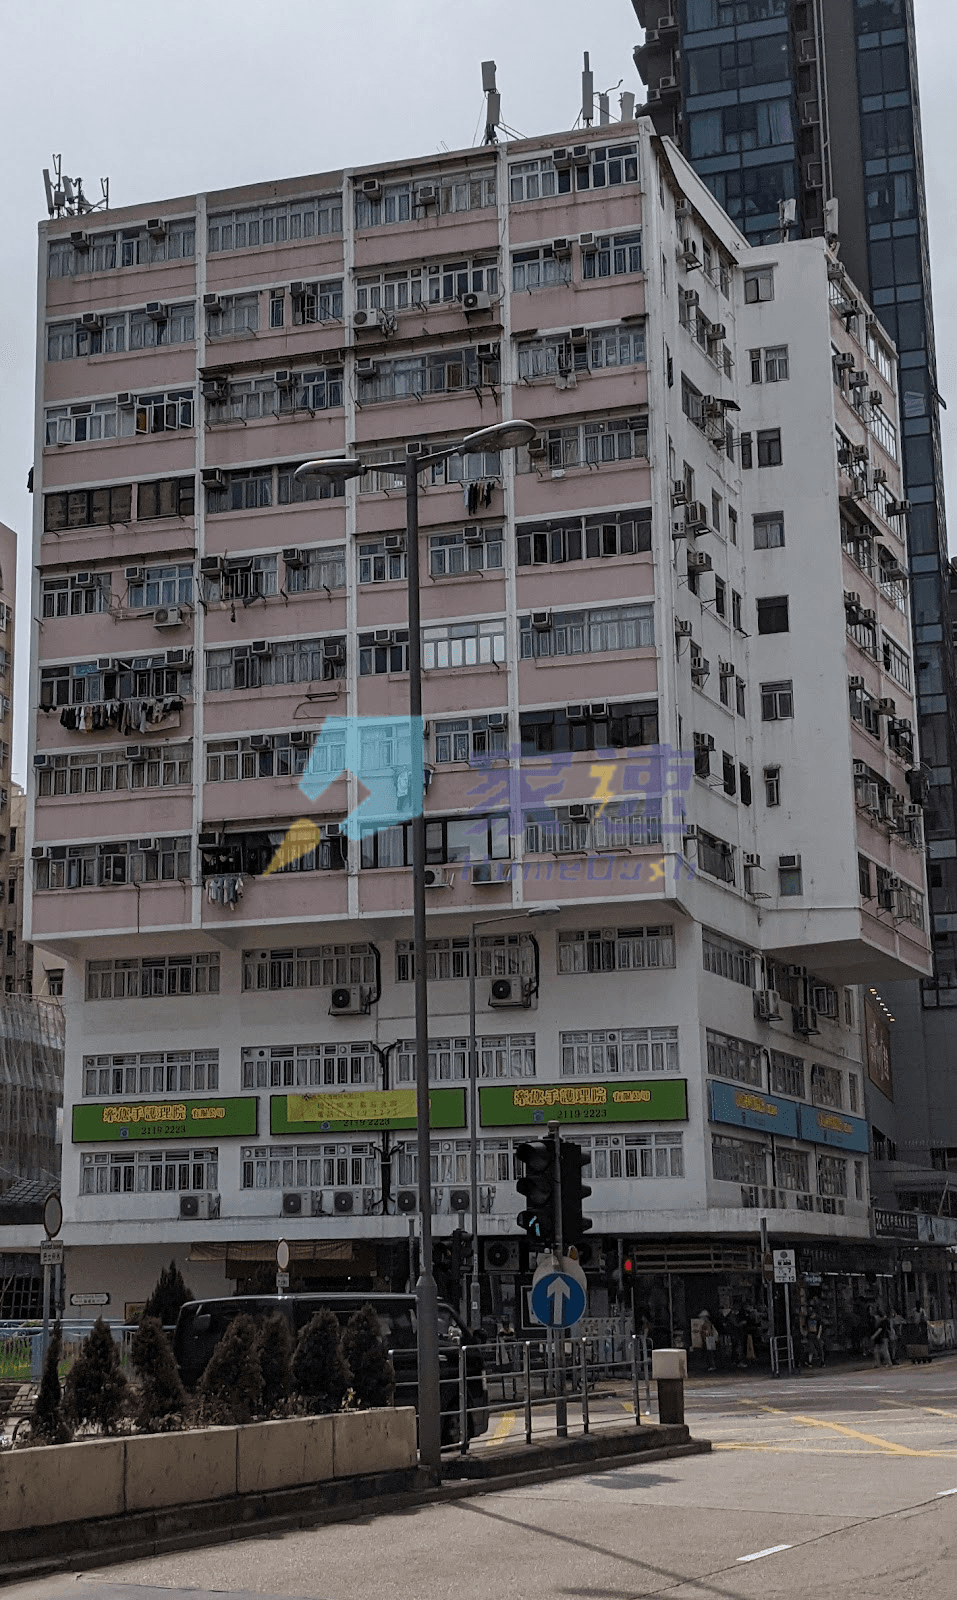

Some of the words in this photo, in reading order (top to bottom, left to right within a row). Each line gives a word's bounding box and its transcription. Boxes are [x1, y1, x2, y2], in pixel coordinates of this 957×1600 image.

[613, 1090, 651, 1103] 有限公司
[557, 1109, 580, 1119] 2119
[583, 1109, 607, 1118] 2223
[141, 1126, 162, 1135] 2119
[164, 1125, 186, 1134] 2223
